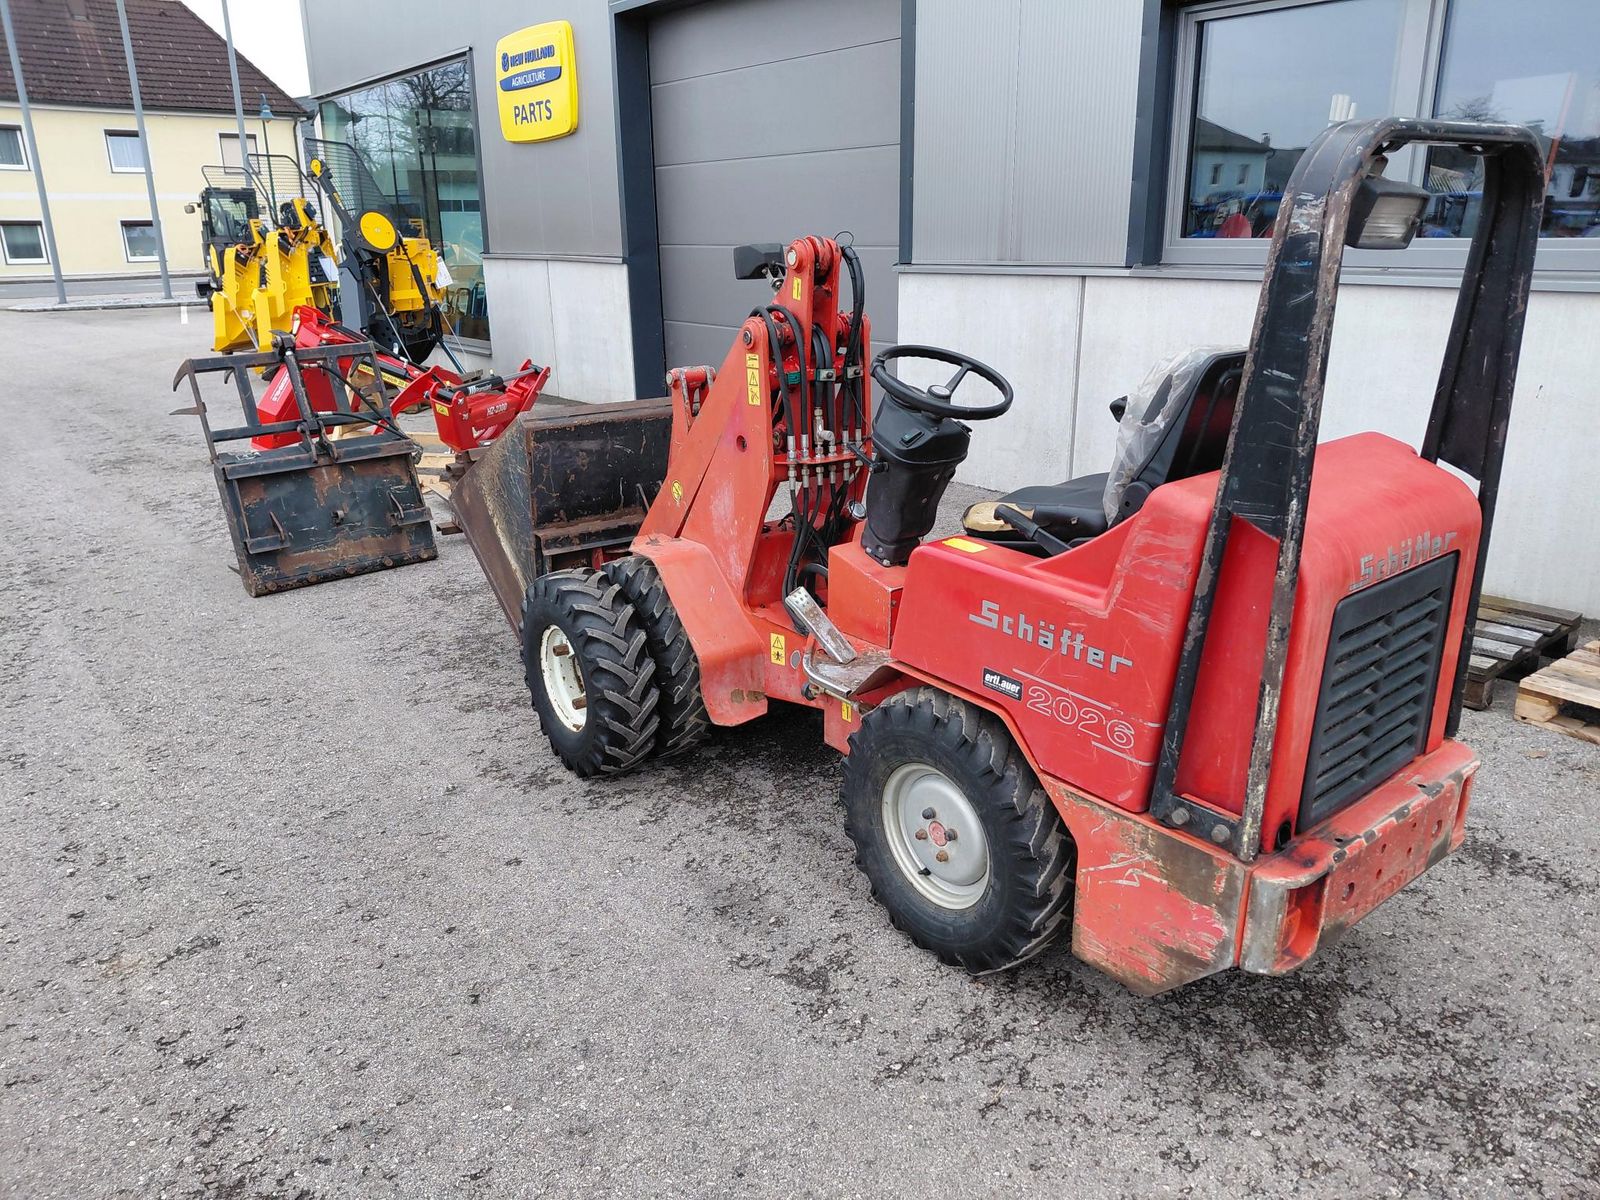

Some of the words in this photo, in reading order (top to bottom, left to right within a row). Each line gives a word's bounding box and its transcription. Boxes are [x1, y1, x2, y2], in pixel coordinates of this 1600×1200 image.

[510, 52, 524, 68] NEW
[525, 44, 555, 64] HOLLAND
[511, 70, 546, 87] AGRICULTURE
[513, 99, 553, 126] PARTS
[1349, 529, 1458, 591] Schäffer
[968, 599, 1133, 673] Schäffer
[984, 673, 1021, 694] ertl.auer
[1026, 685, 1136, 749] 2026
